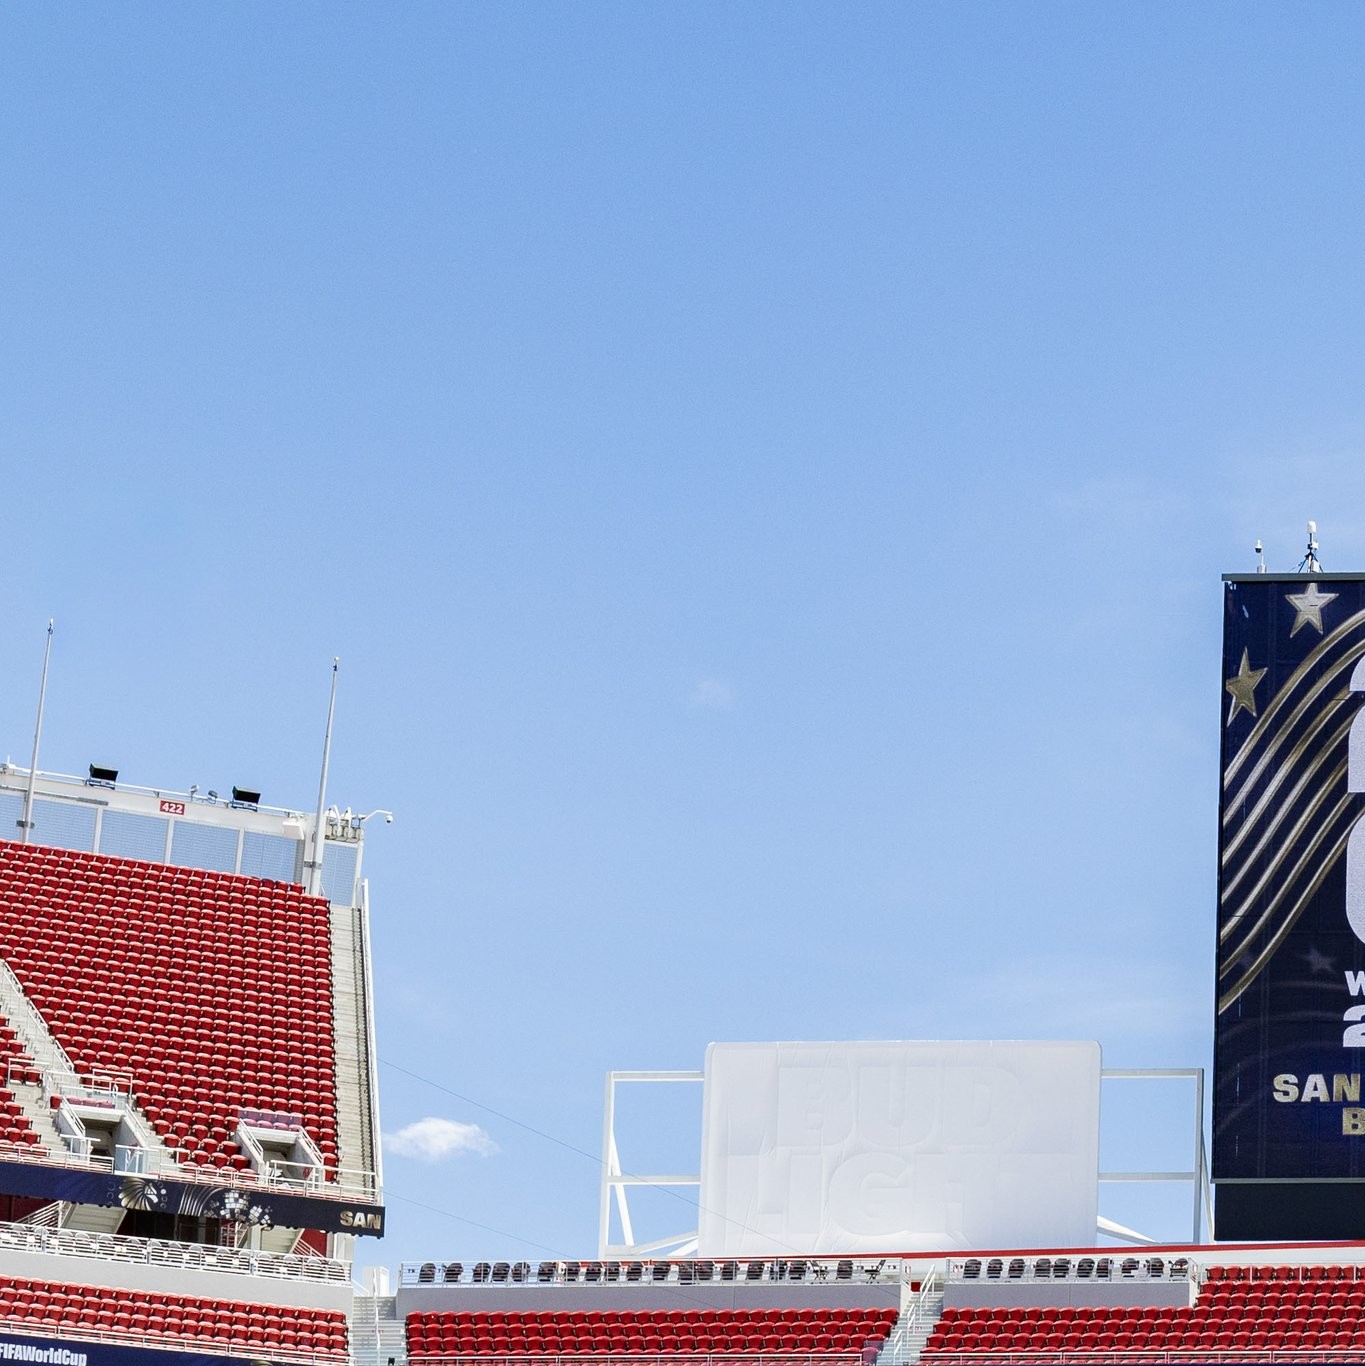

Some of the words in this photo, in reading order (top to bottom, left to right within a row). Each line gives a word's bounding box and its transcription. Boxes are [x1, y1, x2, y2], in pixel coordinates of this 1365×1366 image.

[162, 802, 183, 813] 422
[1272, 1073, 1361, 1103] SAN
[339, 1210, 382, 1230] SAN
